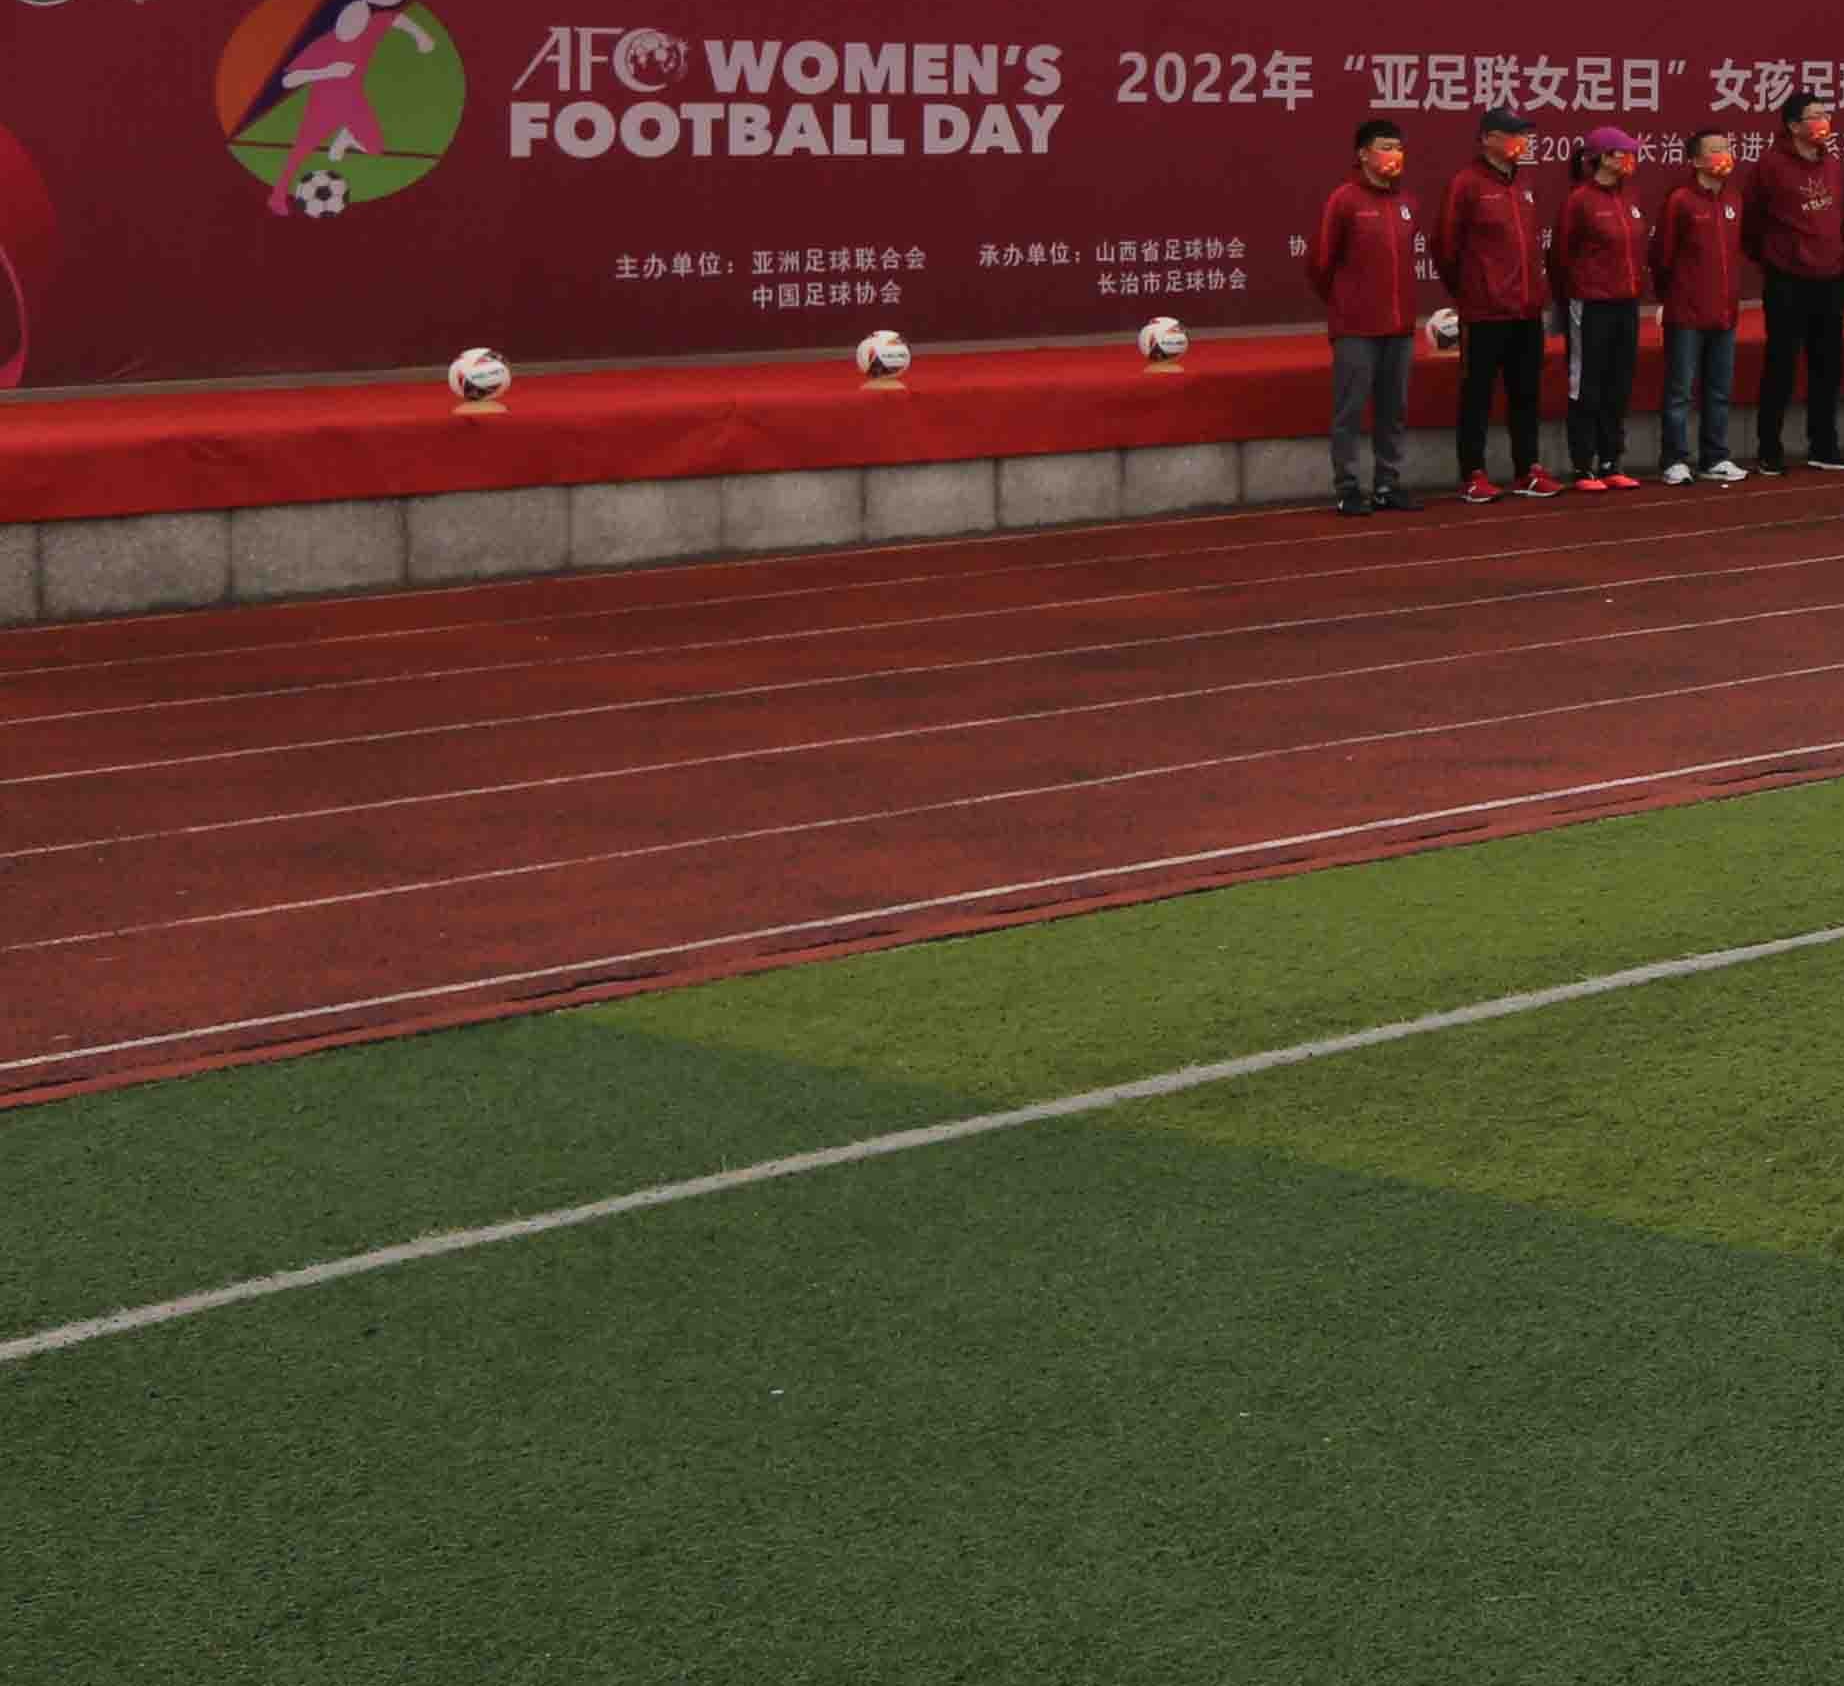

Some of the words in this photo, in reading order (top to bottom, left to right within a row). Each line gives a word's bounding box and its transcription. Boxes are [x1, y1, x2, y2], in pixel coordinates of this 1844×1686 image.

[511, 25, 690, 93] AFC
[704, 40, 1063, 95] WOMEN'S
[510, 101, 905, 158] FOOTBALL
[922, 103, 1065, 155] DAY
[751, 280, 902, 310] 中国足球协会
[1096, 267, 1248, 296] 长治市足球协会
